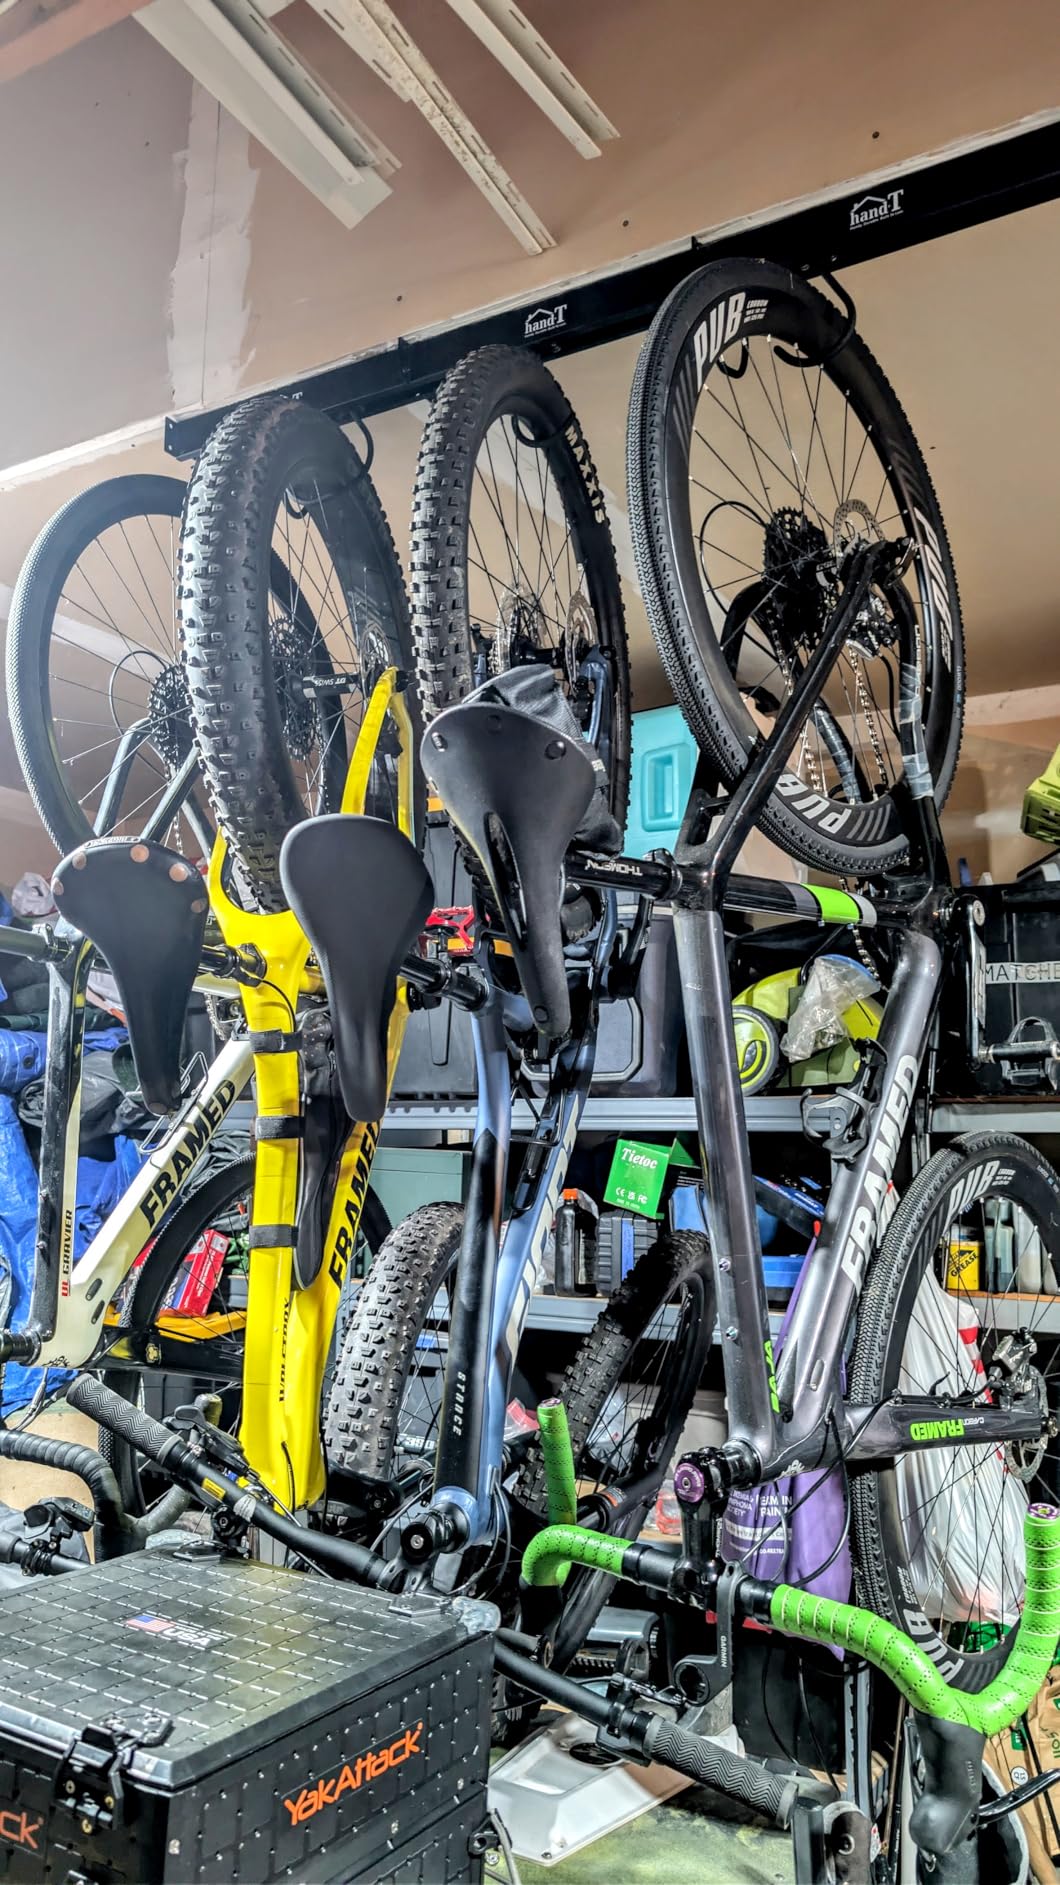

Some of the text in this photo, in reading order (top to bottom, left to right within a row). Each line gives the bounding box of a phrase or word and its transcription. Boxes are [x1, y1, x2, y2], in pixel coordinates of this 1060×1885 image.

[694, 291, 746, 393] PUB
[775, 773, 852, 834] PUB
[140, 1080, 235, 1228] FRAMED
[621, 1147, 658, 1169] Tietoc
[841, 1054, 919, 1298] FRAMED
[942, 1160, 1000, 1237] PUB
[62, 1209, 73, 1275] GRAVIER
[950, 1253, 979, 1278] GREASE
[452, 1371, 466, 1436] STANCE
[909, 1418, 965, 1441] FRAMED
[163, 1628, 211, 1646] USA
[903, 1608, 965, 1683] PUB
[284, 1730, 422, 1826] YakAttack
